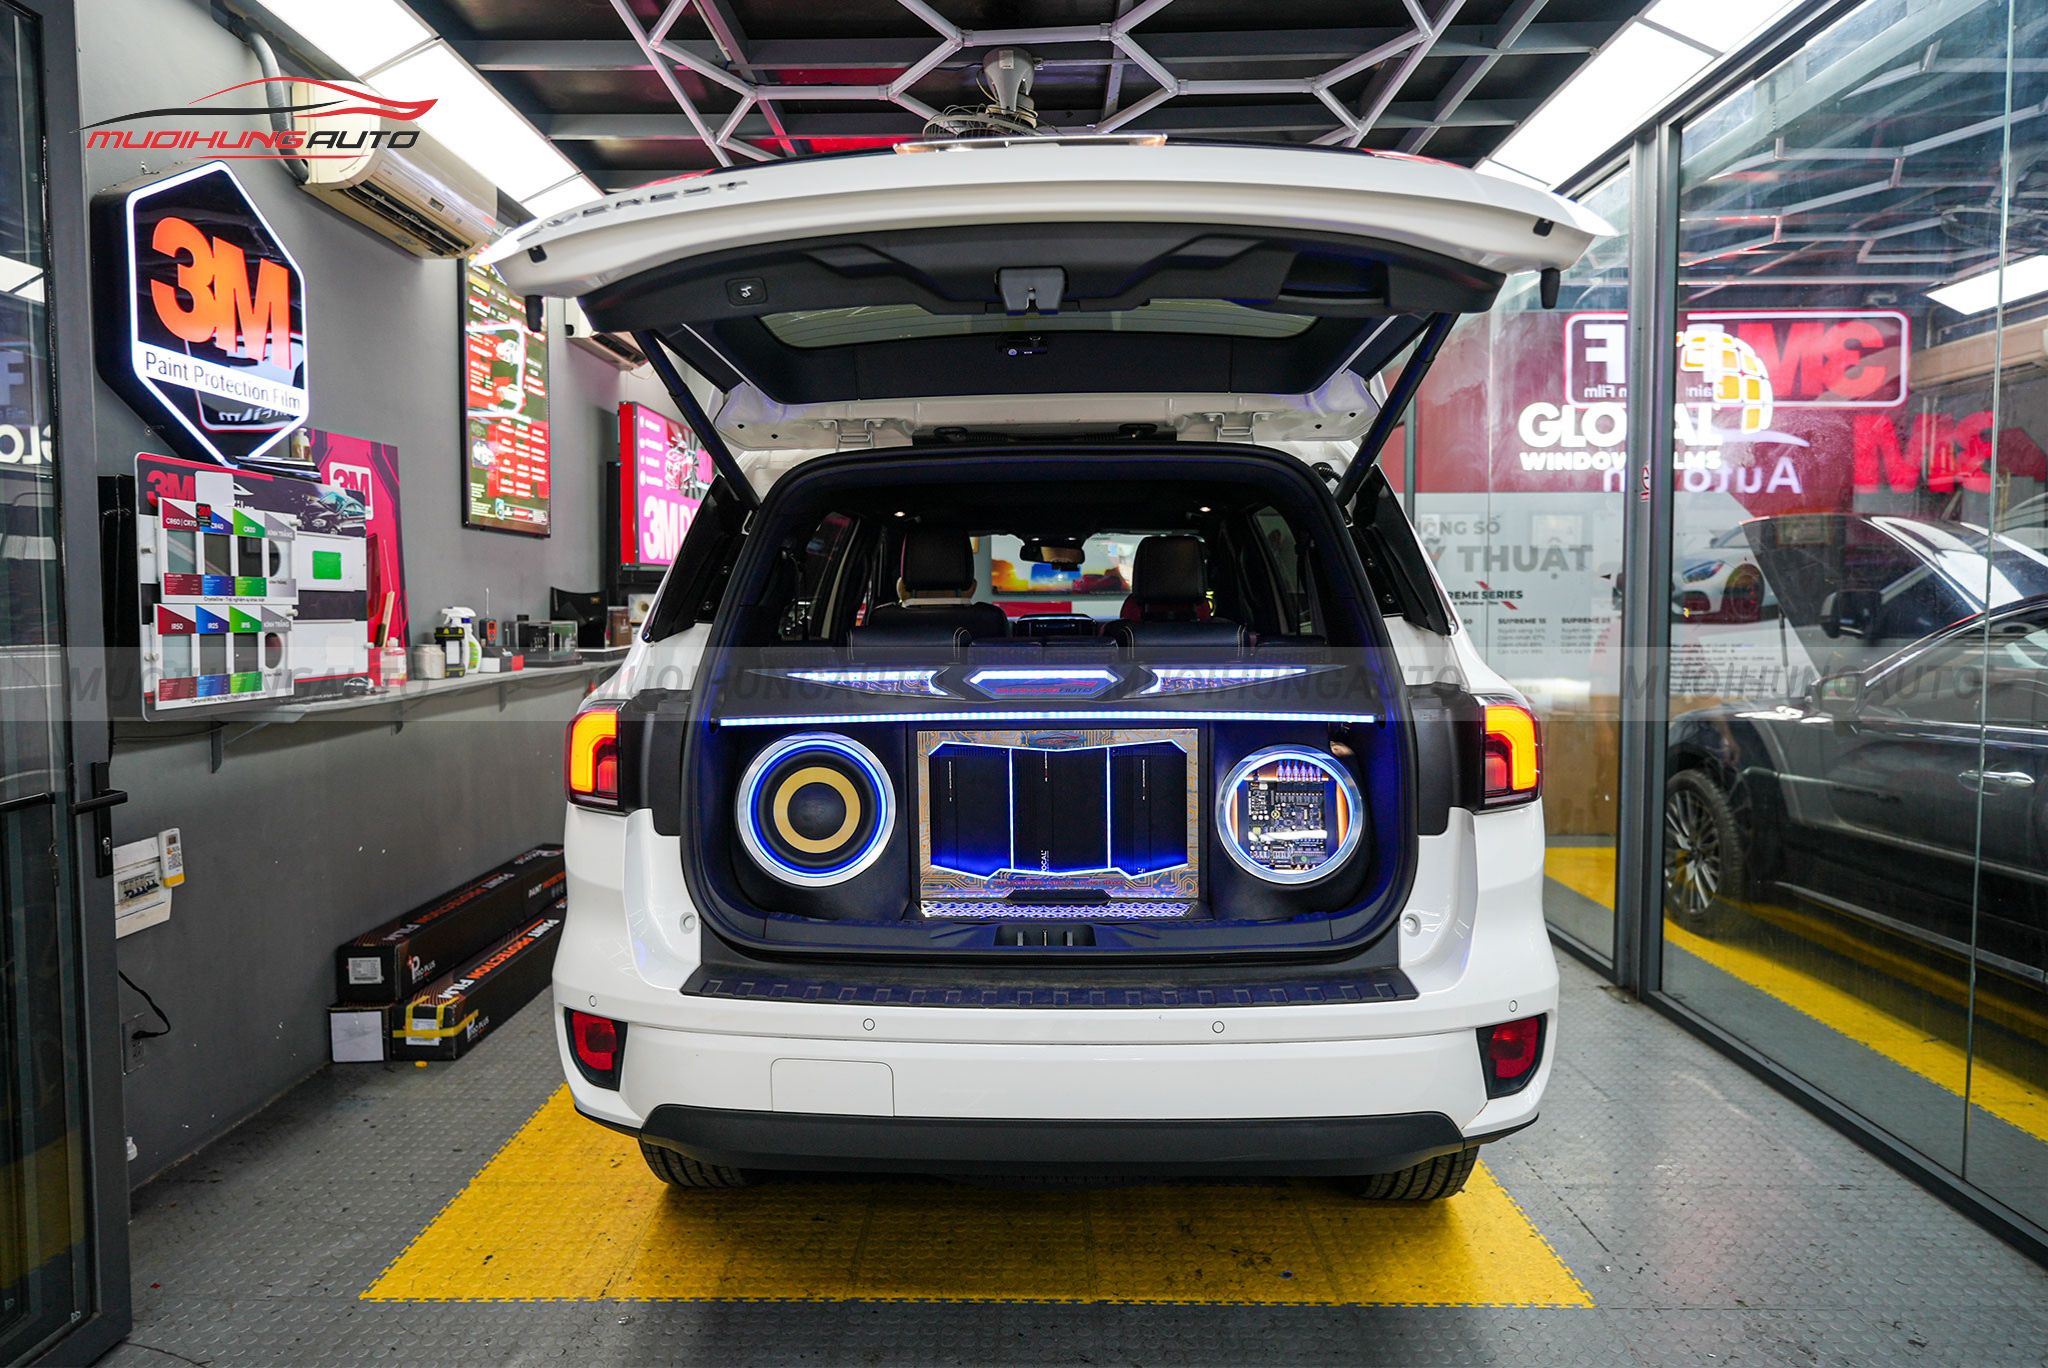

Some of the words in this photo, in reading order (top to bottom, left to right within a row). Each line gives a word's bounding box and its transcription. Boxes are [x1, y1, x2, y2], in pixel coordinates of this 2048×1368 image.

[151, 216, 292, 371] 3M
[145, 351, 190, 381] Paint
[193, 365, 270, 402] Protection
[272, 388, 301, 411] Film
[1518, 402, 1723, 448] GLOAL
[1673, 451, 1723, 471] LMS
[146, 469, 197, 509] 3M
[1473, 514, 1501, 536] SỐ
[1457, 537, 1595, 581] THUẬT
[1447, 591, 1480, 600] REME
[1481, 590, 1523, 600] SERIES
[382, 922, 421, 942] FILM
[466, 936, 536, 980] PROTECTION
[438, 978, 475, 1000] FILM
